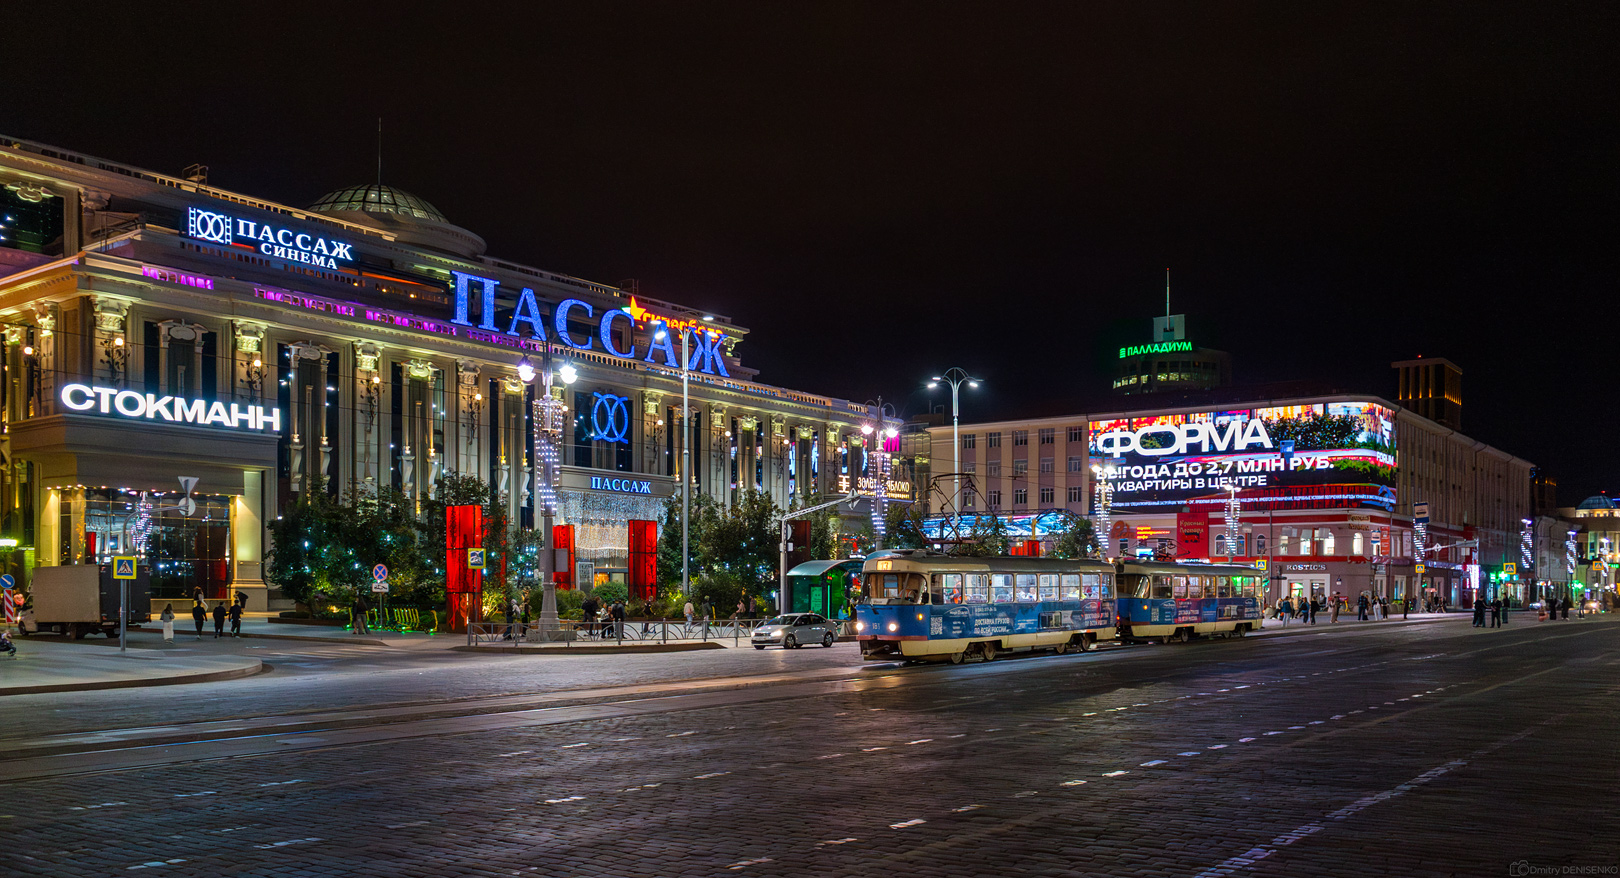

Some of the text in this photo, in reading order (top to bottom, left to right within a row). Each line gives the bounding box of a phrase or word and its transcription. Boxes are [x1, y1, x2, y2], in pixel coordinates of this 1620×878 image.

[236, 218, 353, 261] ПАССАЖ
[260, 242, 338, 270] СИНЕМА
[450, 269, 731, 378] ПАССАЖ
[1127, 341, 1193, 356] ПАЛЛАДИУМ
[61, 383, 280, 432] СТОКМАНН
[1097, 418, 1273, 458] ФОРМА
[1173, 462, 1203, 478] ДО
[1206, 461, 1234, 476] 2,7
[1237, 457, 1285, 473] МЛН
[1289, 456, 1335, 471] РУБ.
[590, 476, 652, 495] ПАССАЖ
[886, 480, 910, 493] ЯБЛОКО
[1117, 479, 1192, 492] КВАРТИРЫ
[1195, 478, 1205, 489] В
[1208, 475, 1267, 490] ЦЕНТРЕ
